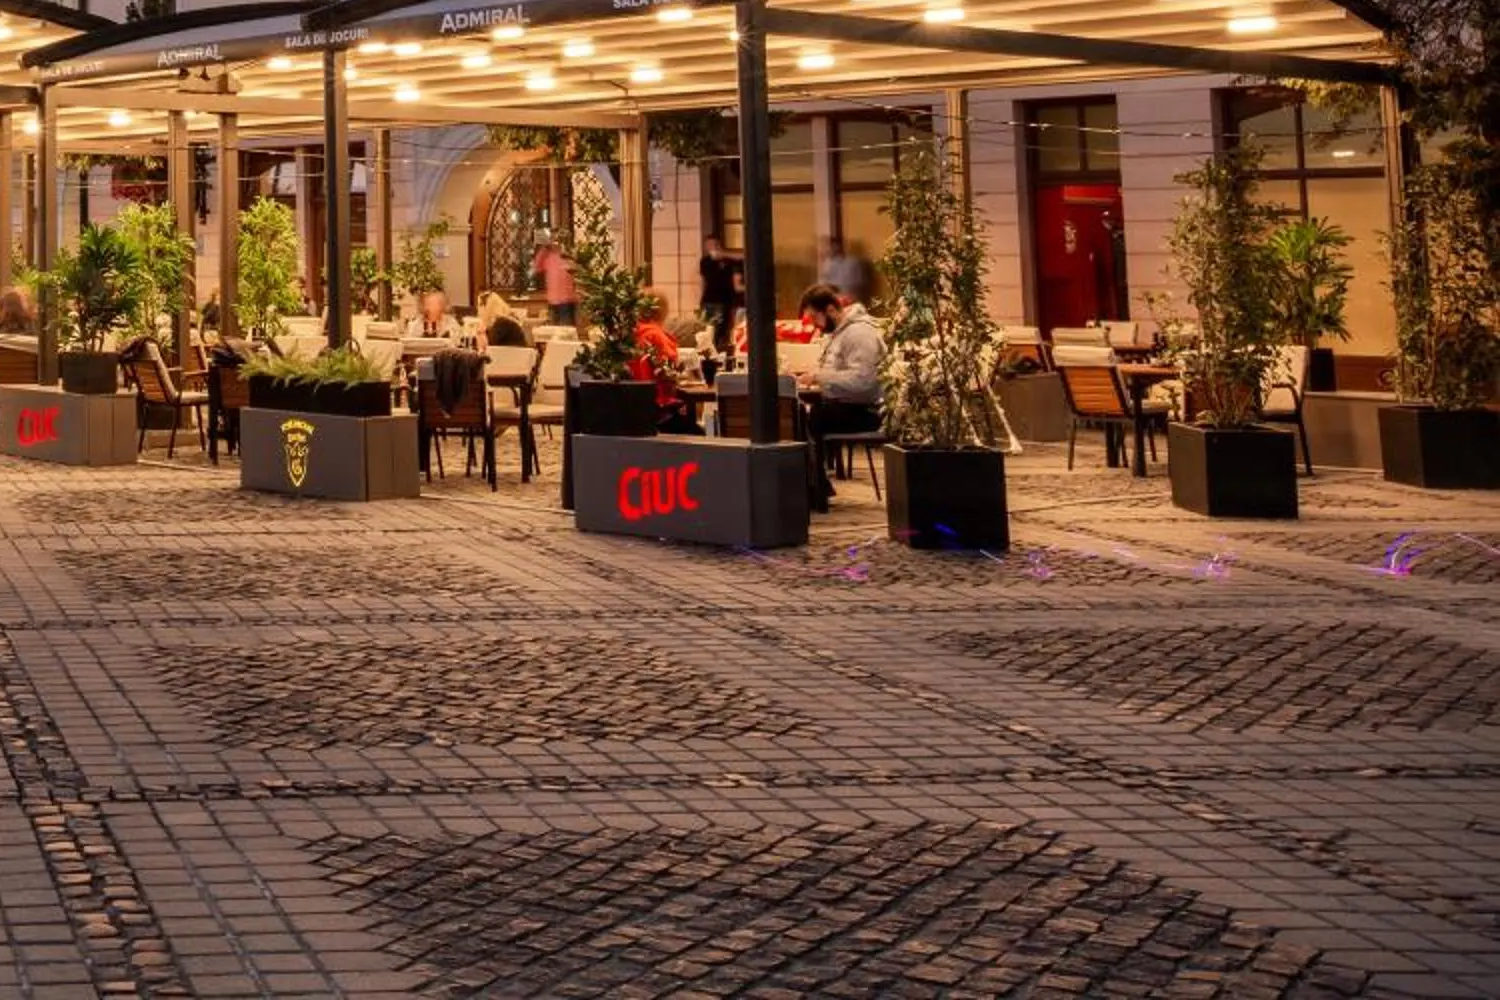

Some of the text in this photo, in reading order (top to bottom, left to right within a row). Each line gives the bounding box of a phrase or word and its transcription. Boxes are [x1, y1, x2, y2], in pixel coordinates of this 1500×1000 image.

[440, 4, 530, 33] ADMIRAL
[285, 33, 311, 49] SALA
[157, 43, 225, 68] ADMIRAL
[618, 461, 699, 520] CIUC
